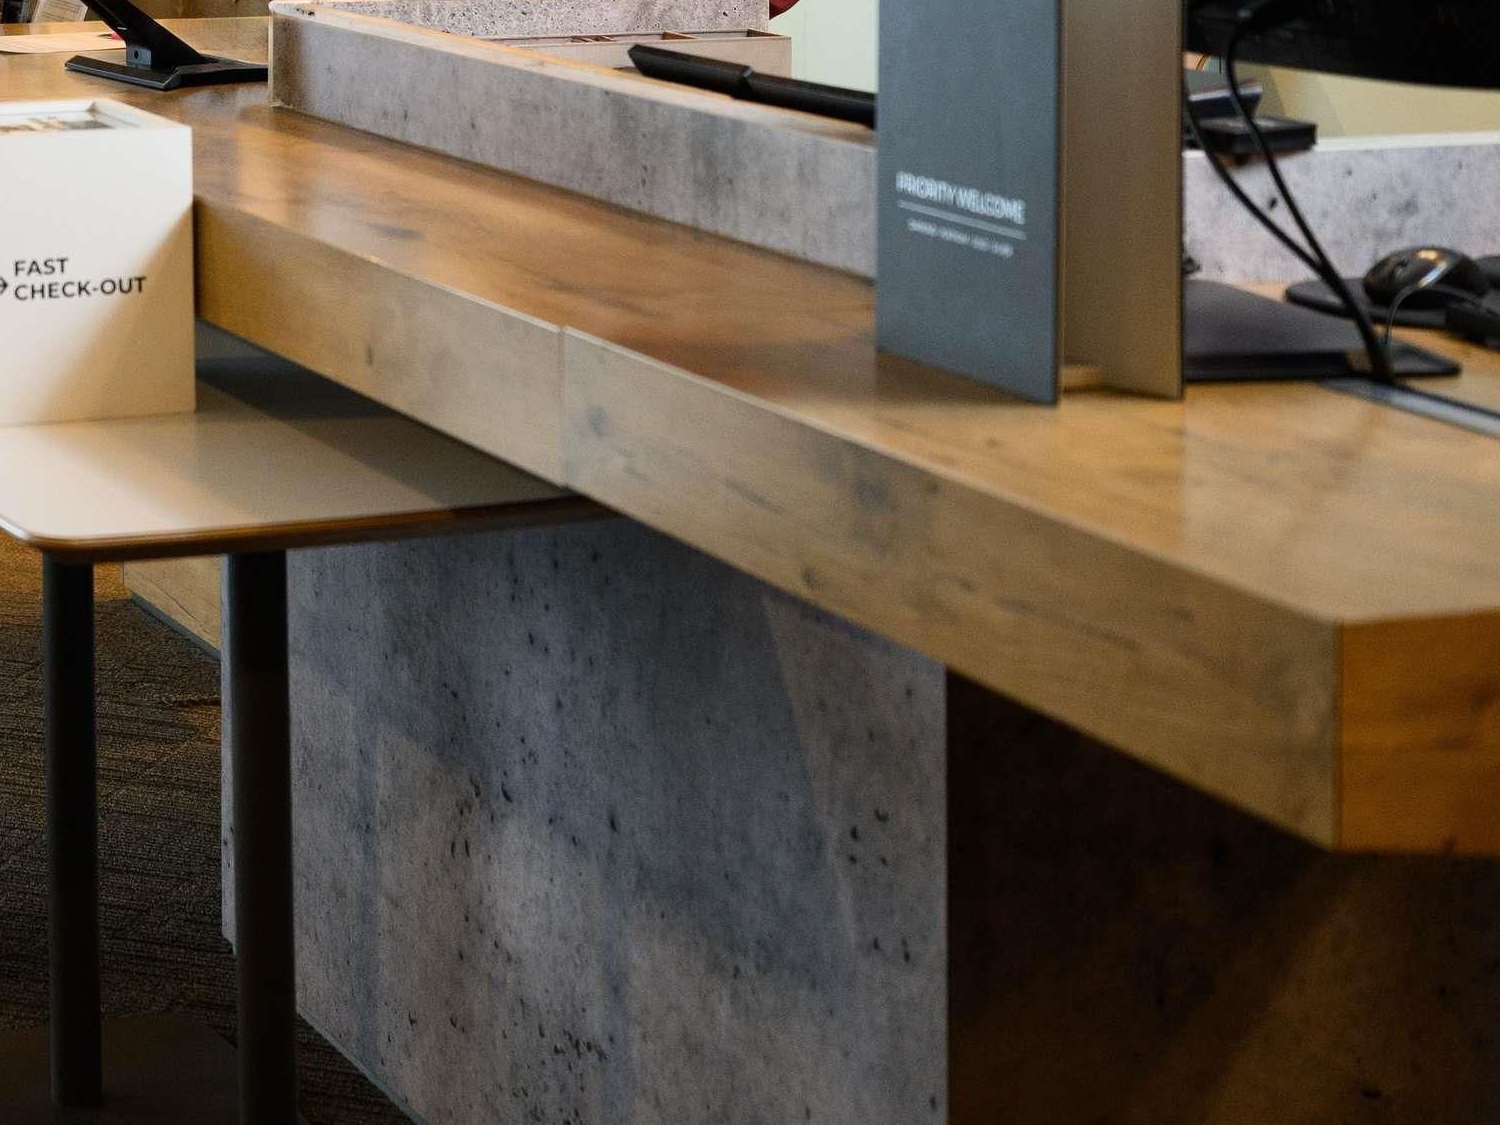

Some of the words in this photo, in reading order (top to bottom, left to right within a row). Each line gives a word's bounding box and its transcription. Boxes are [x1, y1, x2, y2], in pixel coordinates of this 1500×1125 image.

[954, 185, 1026, 225] WELCOME
[14, 257, 69, 276] FAST
[14, 276, 147, 301] CHECK-OUT
